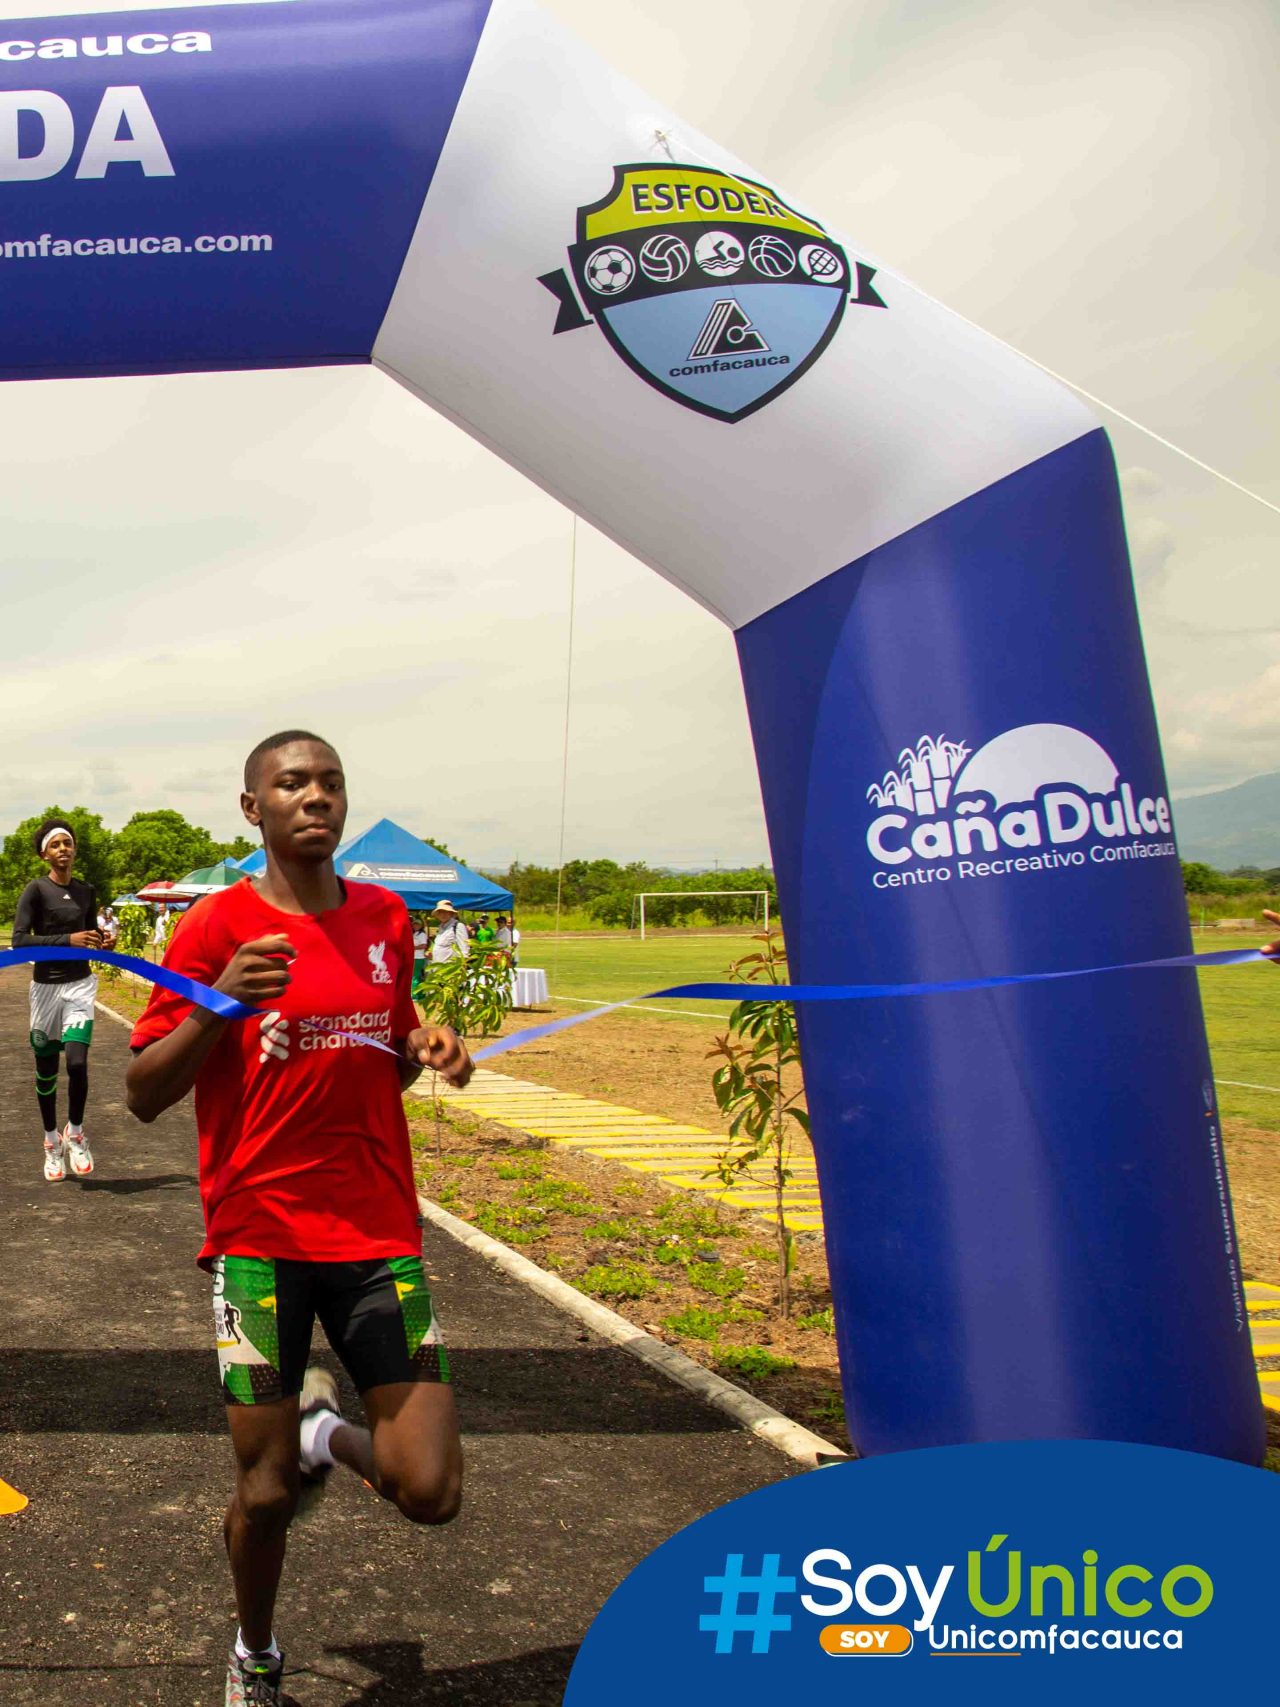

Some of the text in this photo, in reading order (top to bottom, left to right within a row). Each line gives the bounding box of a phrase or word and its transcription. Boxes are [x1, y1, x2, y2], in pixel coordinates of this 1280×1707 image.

[631, 184, 788, 220] ESFODER
[669, 355, 790, 377] comfacauca
[872, 840, 1177, 890] Centro Recreativo Comfacauca
[299, 1009, 390, 1033] standard
[299, 1026, 391, 1050] chartered
